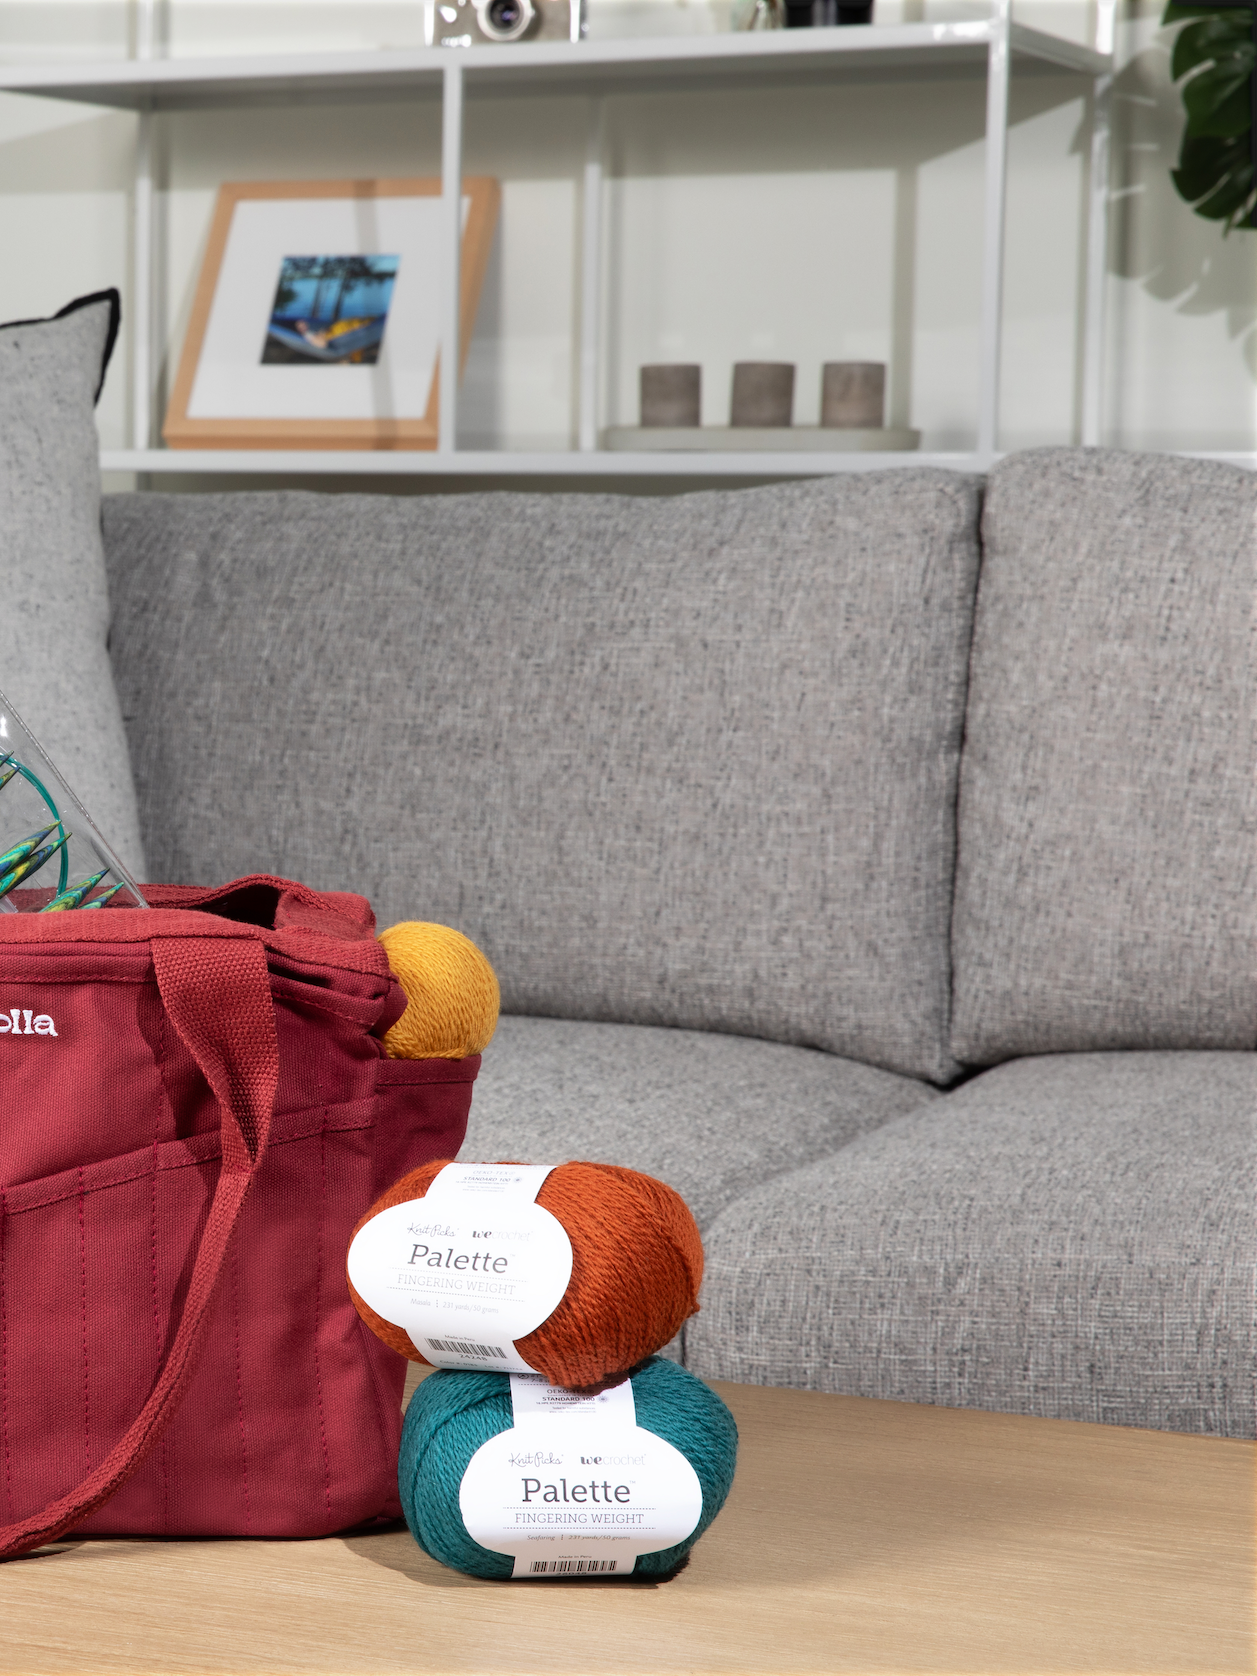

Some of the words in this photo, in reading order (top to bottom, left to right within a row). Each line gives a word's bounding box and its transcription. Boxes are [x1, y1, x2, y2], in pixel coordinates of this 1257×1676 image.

[407, 1243, 508, 1274] Palette
[397, 1273, 463, 1290] FINGERING
[466, 1280, 516, 1295] WEIGHT
[443, 1301, 454, 1309] 231
[521, 1478, 630, 1503] Palette
[515, 1513, 588, 1524] FINGERING
[591, 1513, 644, 1524] WEIGHT
